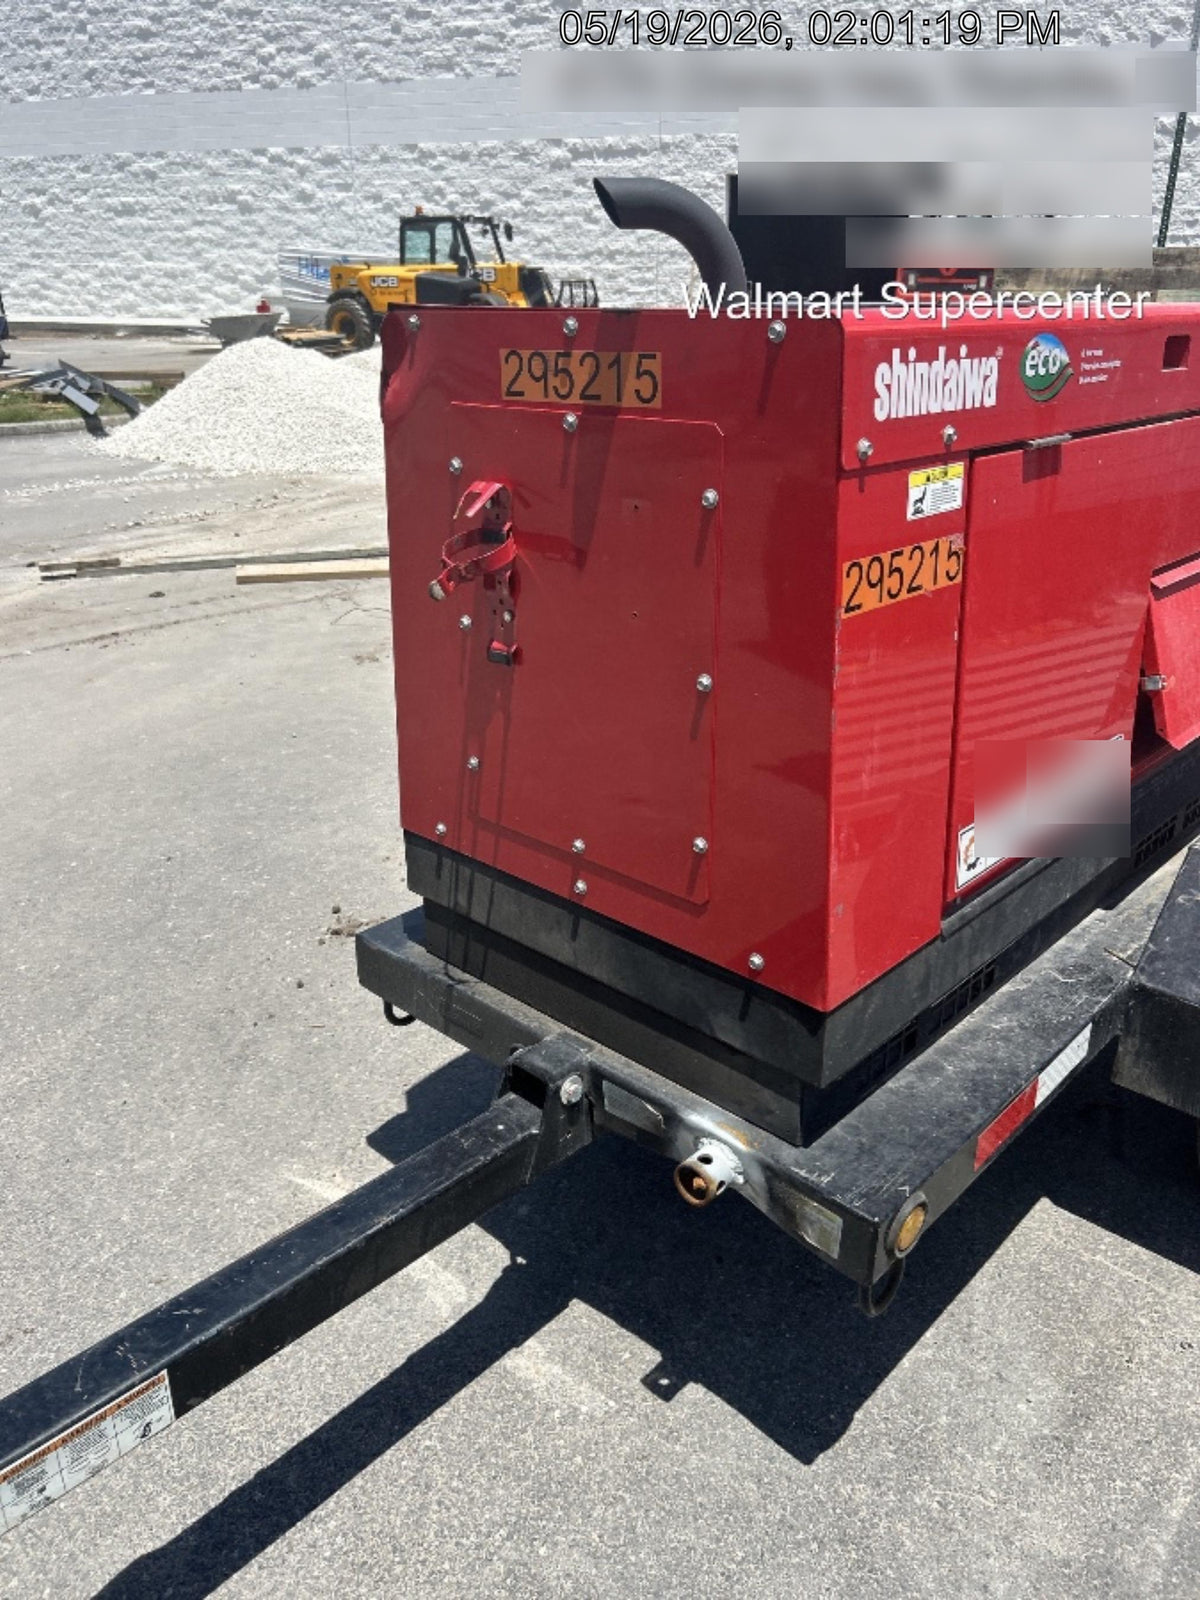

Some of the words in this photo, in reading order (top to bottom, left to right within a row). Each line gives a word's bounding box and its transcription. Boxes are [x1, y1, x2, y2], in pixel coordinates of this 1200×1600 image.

[370, 276, 399, 287] JCB
[504, 350, 659, 404] 295215
[844, 540, 962, 614] 295215
